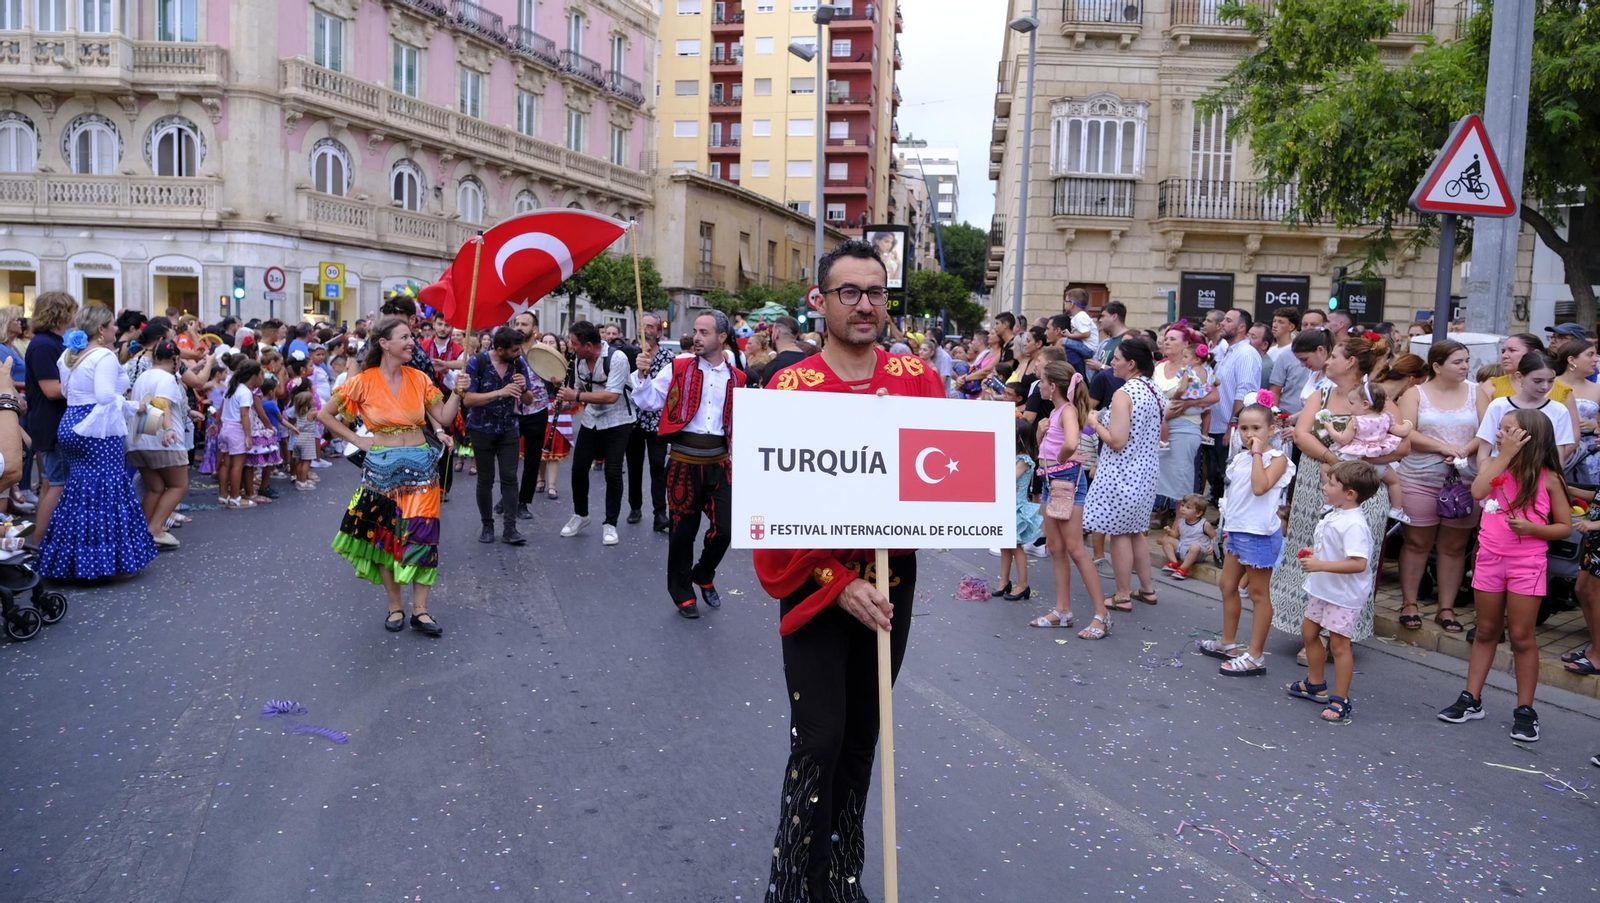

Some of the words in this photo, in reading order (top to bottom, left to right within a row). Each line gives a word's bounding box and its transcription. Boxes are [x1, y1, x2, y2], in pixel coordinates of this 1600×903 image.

[327, 268, 338, 276] 30
[758, 445, 888, 477] TURQUÍA
[770, 524, 828, 536] FESTIVAL
[830, 524, 927, 536] INTERNACIONAL
[929, 525, 945, 536] DE
[947, 525, 1004, 537] FOLCLORE
